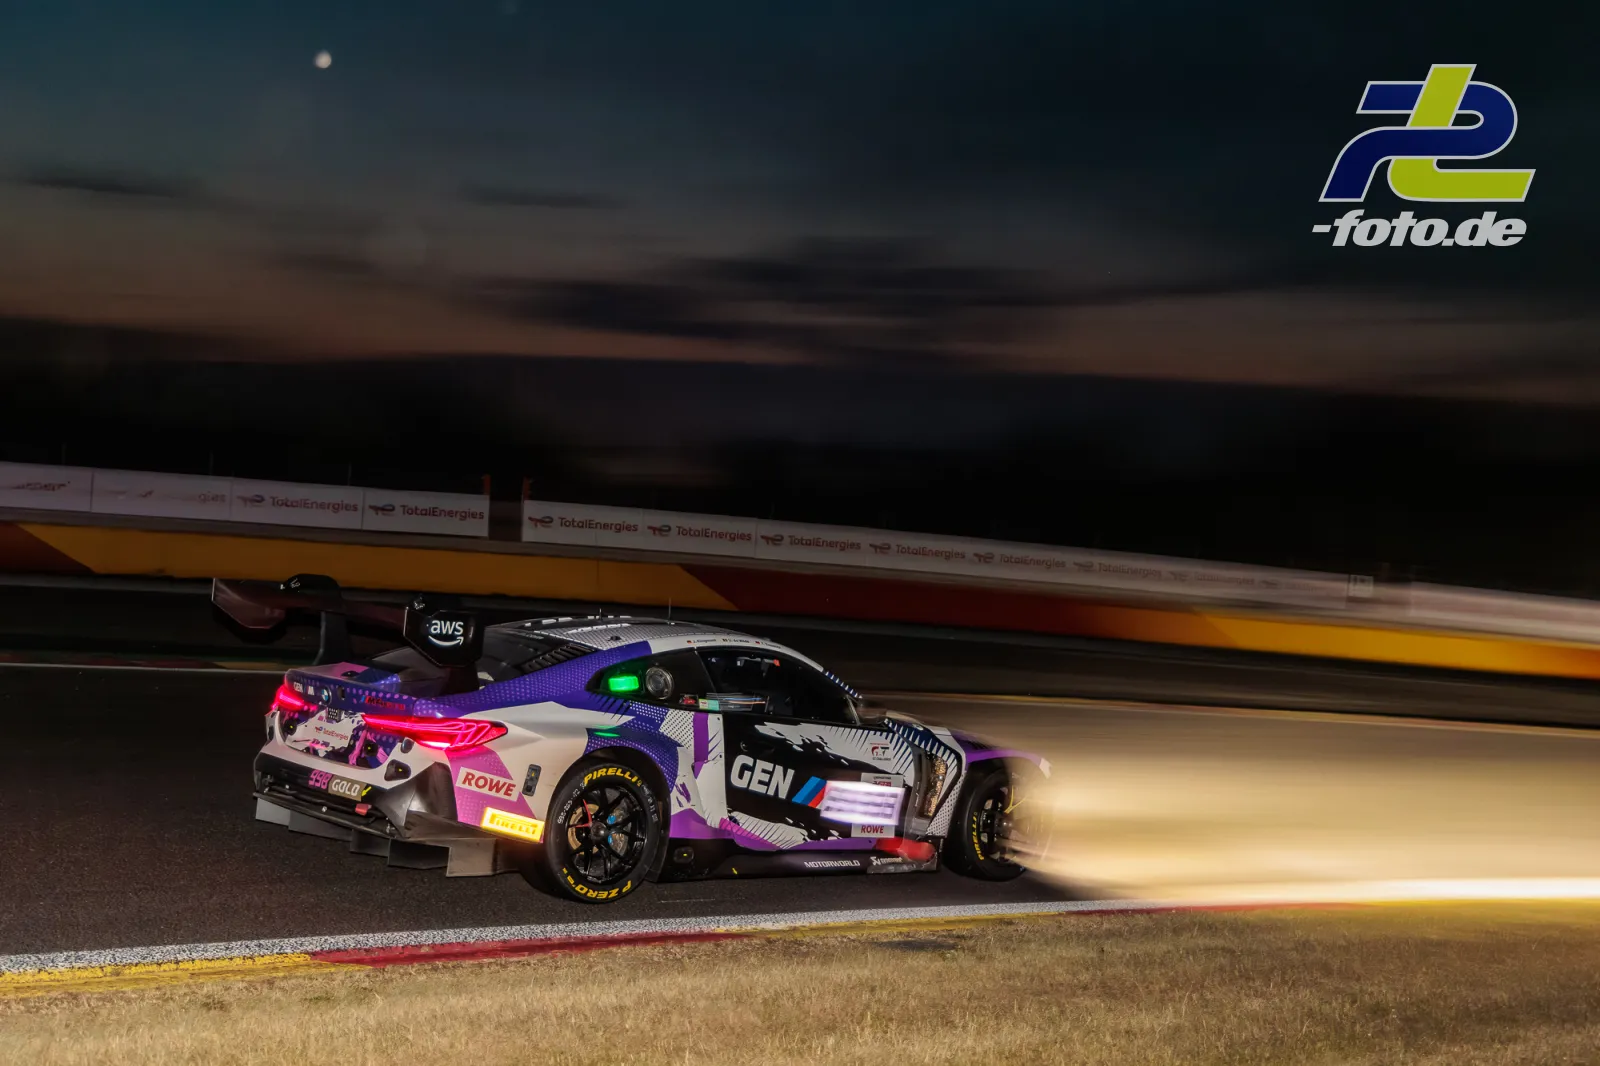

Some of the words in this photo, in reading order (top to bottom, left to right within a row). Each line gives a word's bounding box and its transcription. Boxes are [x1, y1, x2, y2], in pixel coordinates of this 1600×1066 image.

[270, 496, 358, 513] TotalEnergies
[400, 504, 485, 521] TotalEnergies
[558, 517, 639, 533] TotalEnergies
[676, 526, 752, 542] TotalEnergies
[788, 535, 861, 551] TotalEnergies
[896, 544, 966, 561] TotalEnergies
[1000, 553, 1066, 569] TotalEnergies
[430, 618, 464, 635] aws
[308, 769, 332, 790] 998
[331, 779, 361, 797] GOLD
[461, 771, 517, 797] ROWE
[583, 767, 642, 787] PIRELLI
[730, 754, 795, 799] GEN
[860, 824, 884, 834] ROWE
[804, 859, 861, 868] MOTORWORLD
[575, 884, 620, 899] ZERO
